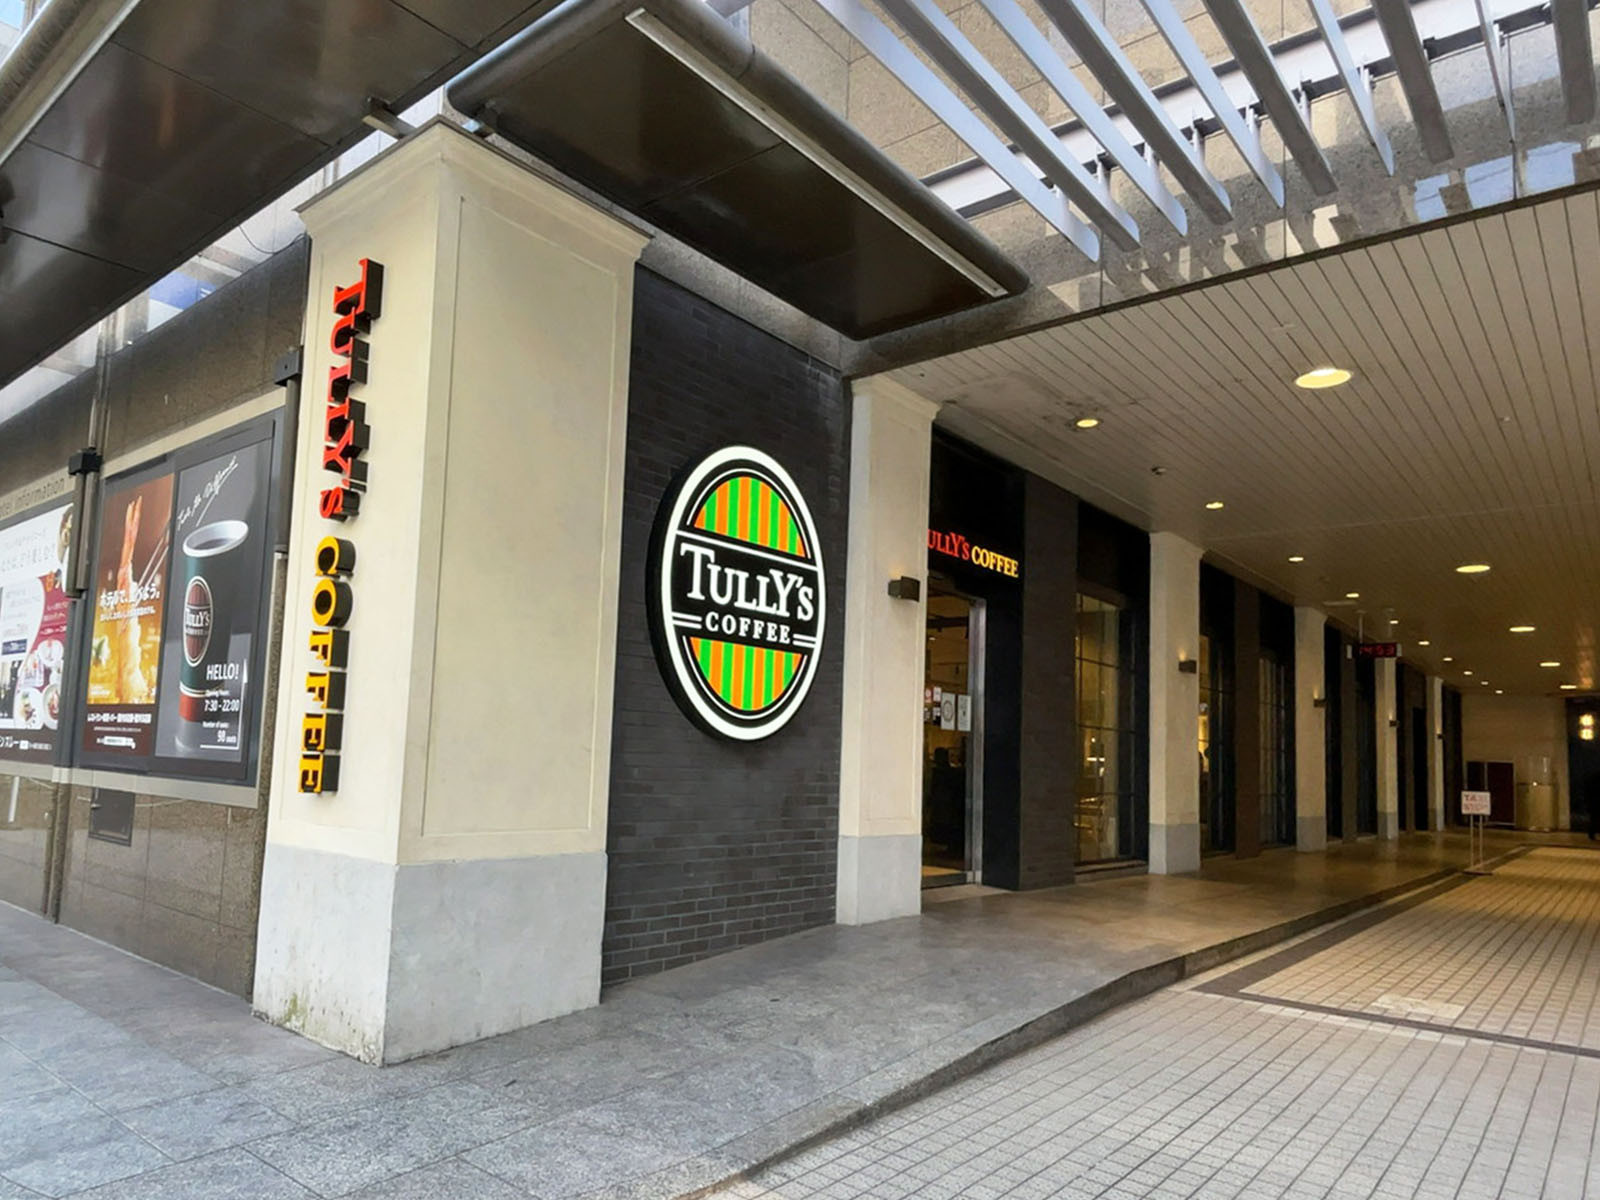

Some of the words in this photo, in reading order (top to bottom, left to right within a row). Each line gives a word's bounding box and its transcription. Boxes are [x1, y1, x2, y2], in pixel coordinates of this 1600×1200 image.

[928, 529, 970, 560] ULLY'S
[971, 545, 1019, 578] COFFEE
[705, 611, 791, 644] COFFEE
[206, 663, 239, 680] HELLO!
[298, 536, 340, 793] COFFEE
